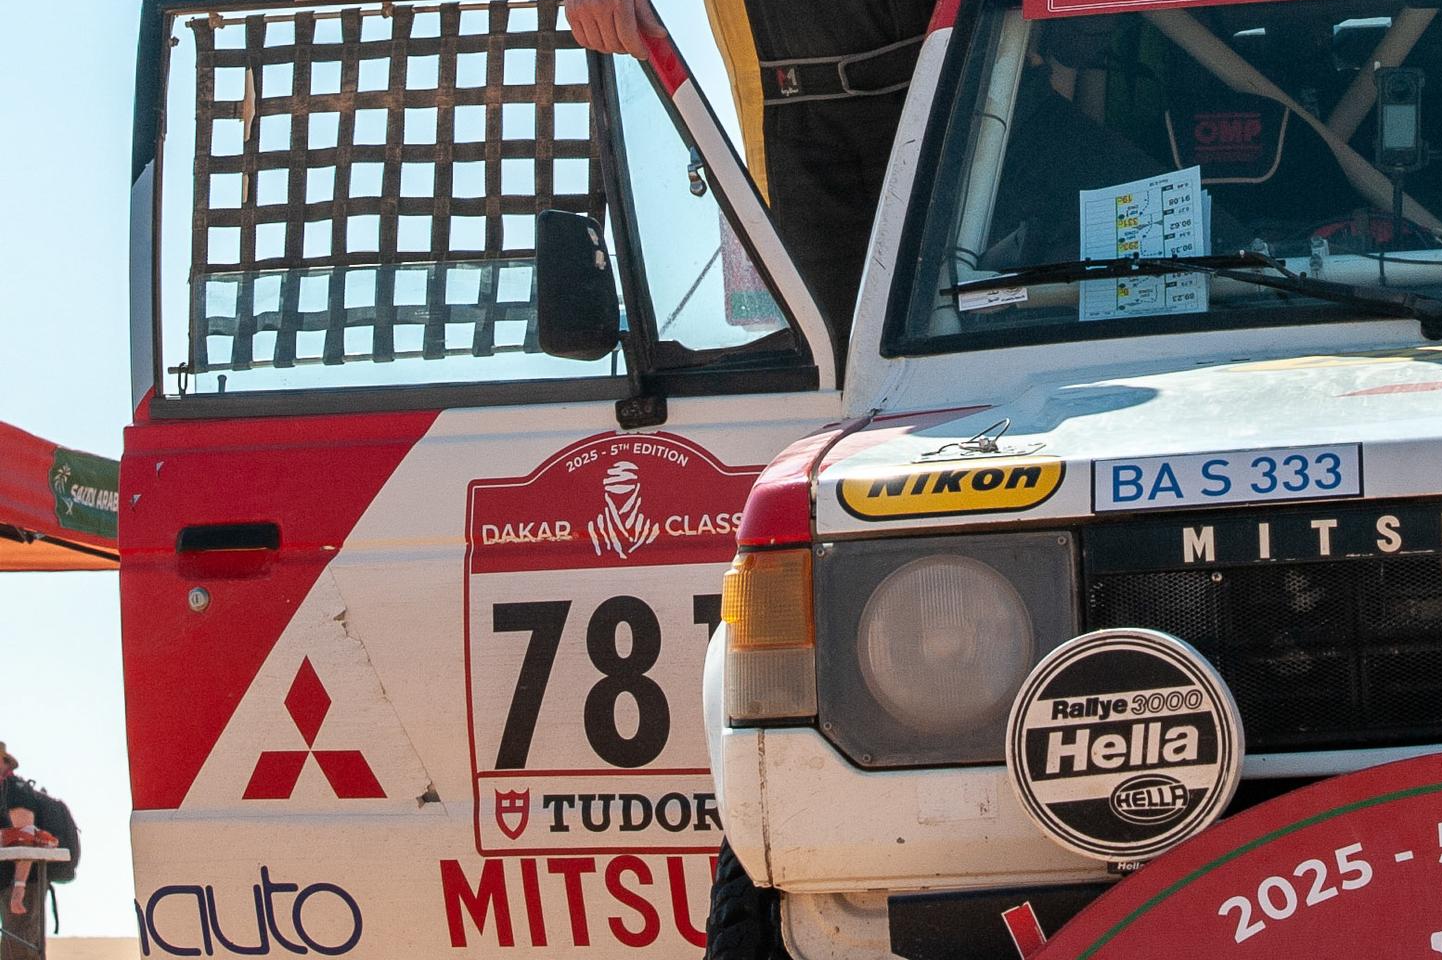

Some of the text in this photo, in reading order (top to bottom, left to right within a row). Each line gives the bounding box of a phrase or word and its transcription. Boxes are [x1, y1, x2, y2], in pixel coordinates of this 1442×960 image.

[565, 451, 598, 473] 2025
[610, 443, 630, 456] 5TH
[633, 443, 689, 468] EDITION
[867, 463, 1045, 499] Nikon
[1112, 453, 1342, 502] BA S 333
[71, 484, 119, 512] SAUDI ARAB
[481, 512, 742, 545] DAKAR CLASS
[1051, 689, 1203, 720] Rallye 3000
[1045, 722, 1199, 775] Hella
[543, 792, 724, 833] TUDOR
[1115, 783, 1189, 809] HELLA
[440, 854, 718, 948] MITSU
[1219, 841, 1374, 945] 2025
